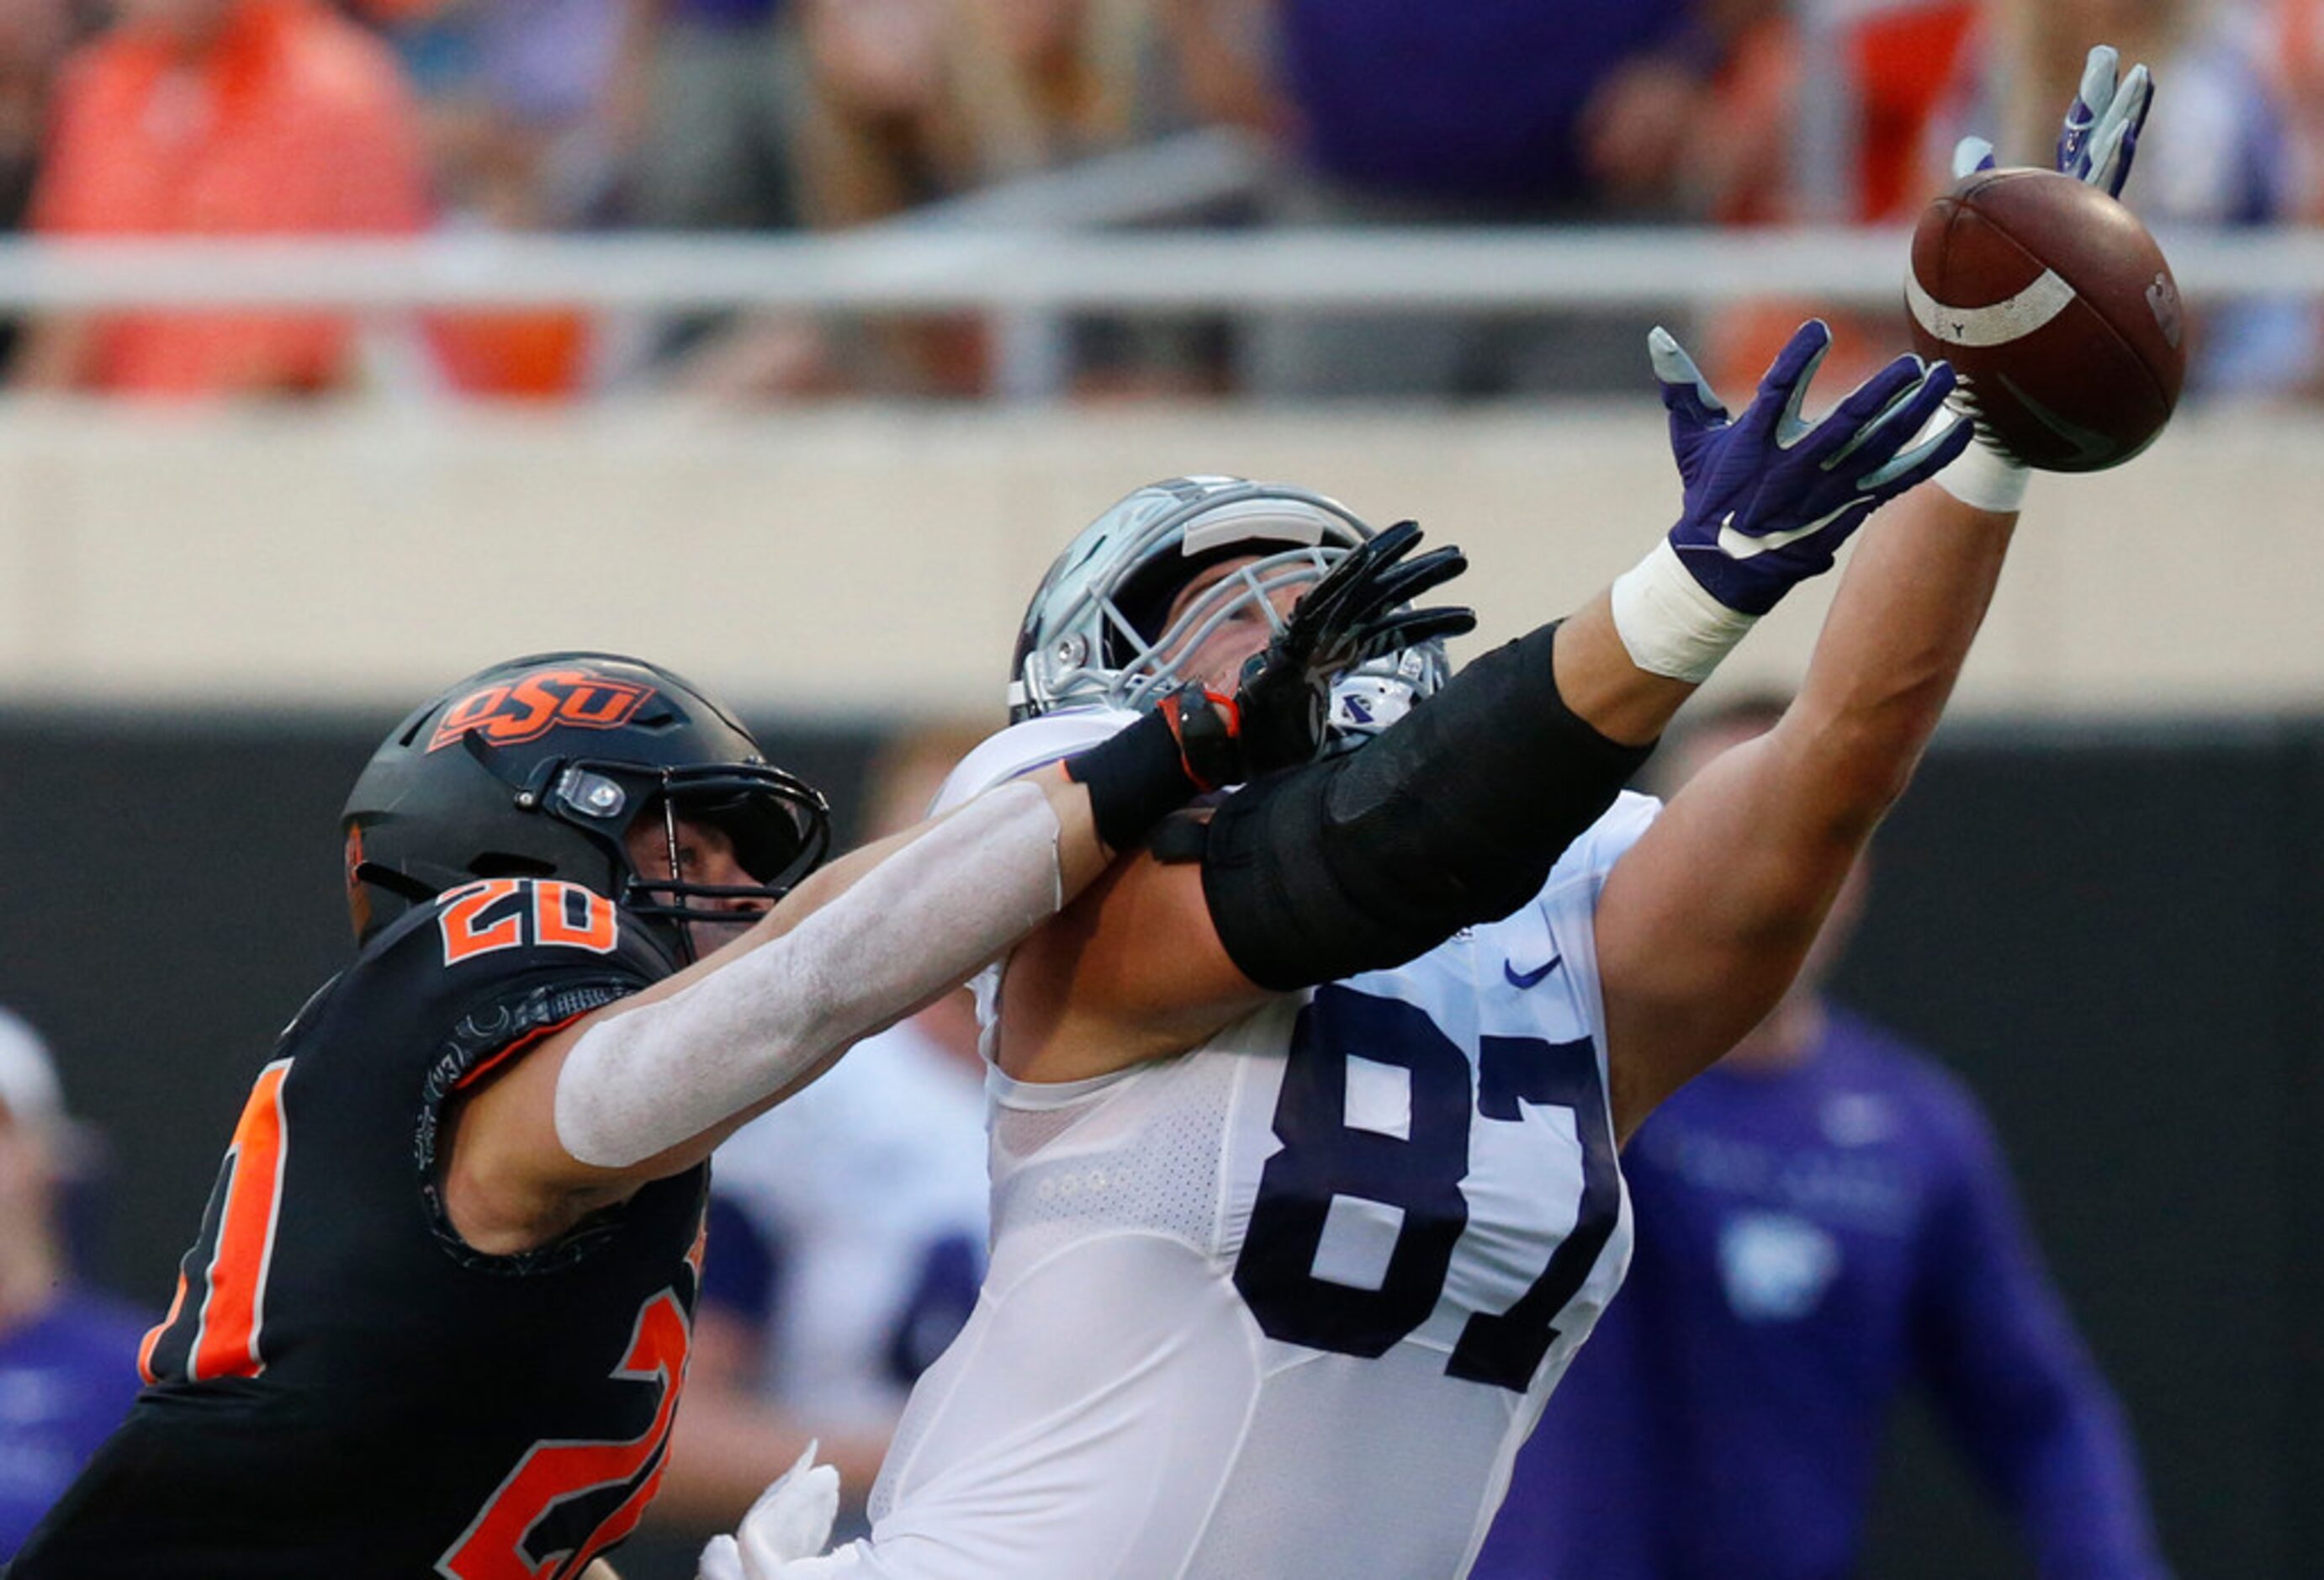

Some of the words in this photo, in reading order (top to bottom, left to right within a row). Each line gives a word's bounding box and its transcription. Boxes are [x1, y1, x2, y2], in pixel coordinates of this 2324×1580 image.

[429, 668, 656, 750] OSU
[435, 878, 618, 967] 20
[1233, 983, 1621, 1394] 87
